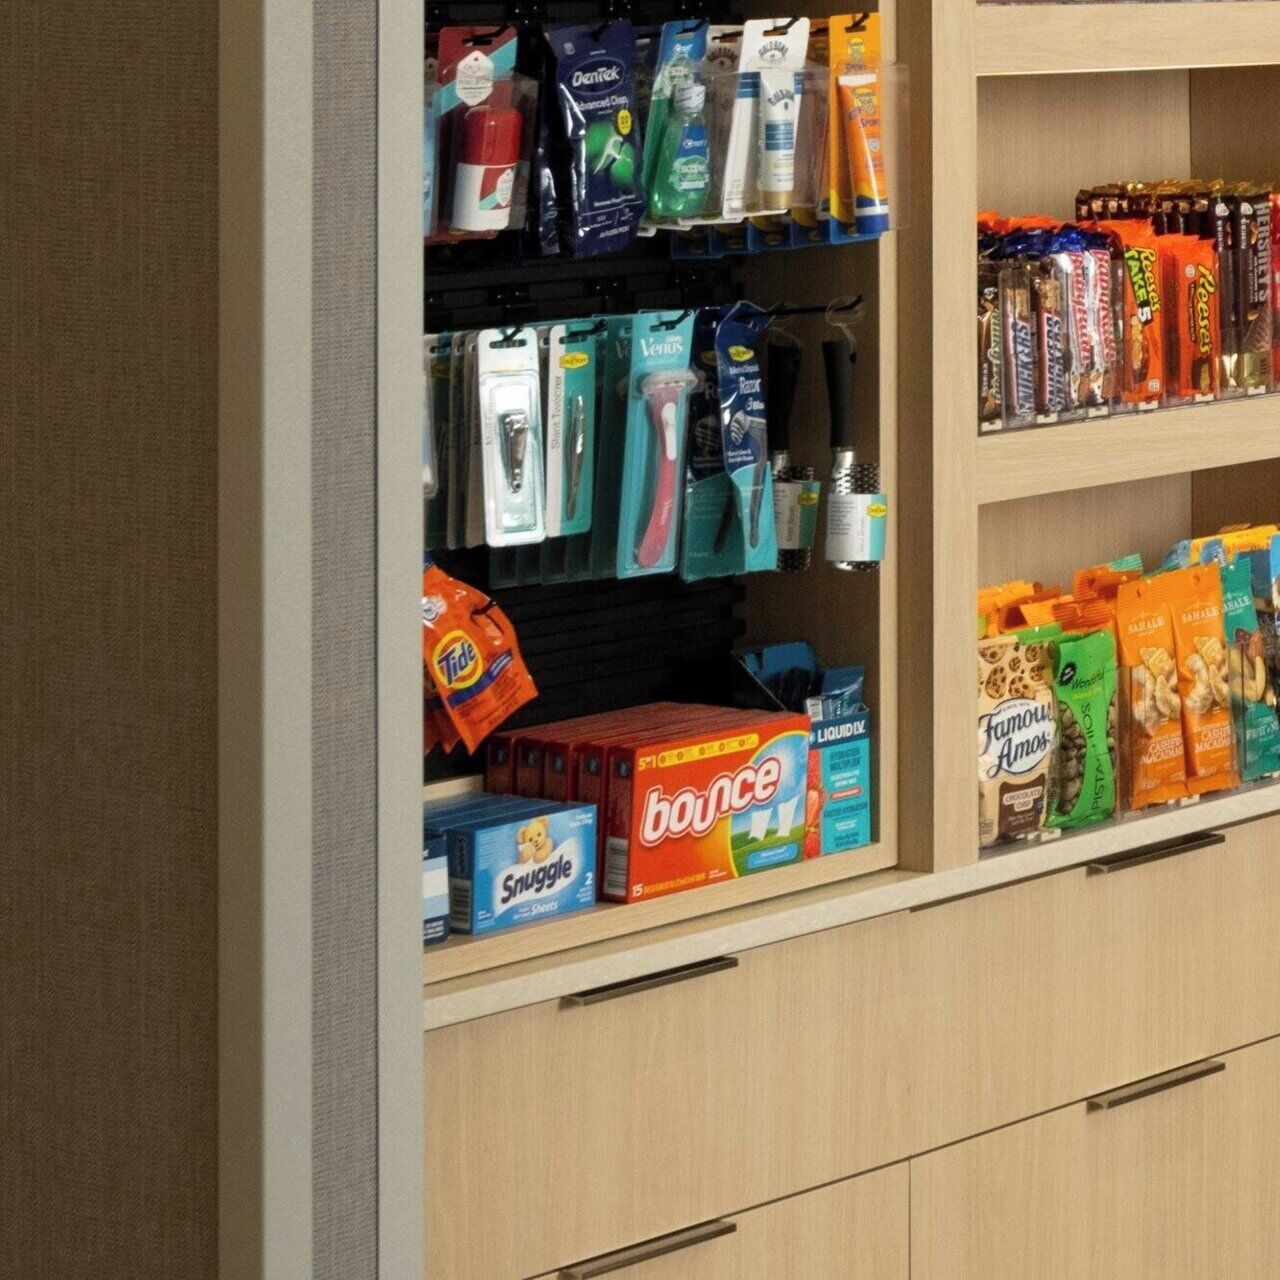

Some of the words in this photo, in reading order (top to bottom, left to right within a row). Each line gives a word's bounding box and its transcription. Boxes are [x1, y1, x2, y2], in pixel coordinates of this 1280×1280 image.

[572, 66, 620, 87] DenTek
[1125, 248, 1148, 303] TAKE
[1137, 306, 1152, 322] 5
[1197, 264, 1216, 354] Reese's
[640, 337, 684, 357] Venus
[1181, 605, 1220, 624] SAHALE
[436, 639, 476, 688] Tide
[817, 723, 853, 743] LIQUID
[987, 733, 1050, 779] Amos
[639, 756, 782, 848] bounce
[1005, 787, 1042, 804] CHOCOLATE
[1016, 800, 1031, 810] CHIP
[501, 854, 573, 904] Snuggle
[585, 872, 593, 886] 2
[531, 901, 558, 915] Sheets
